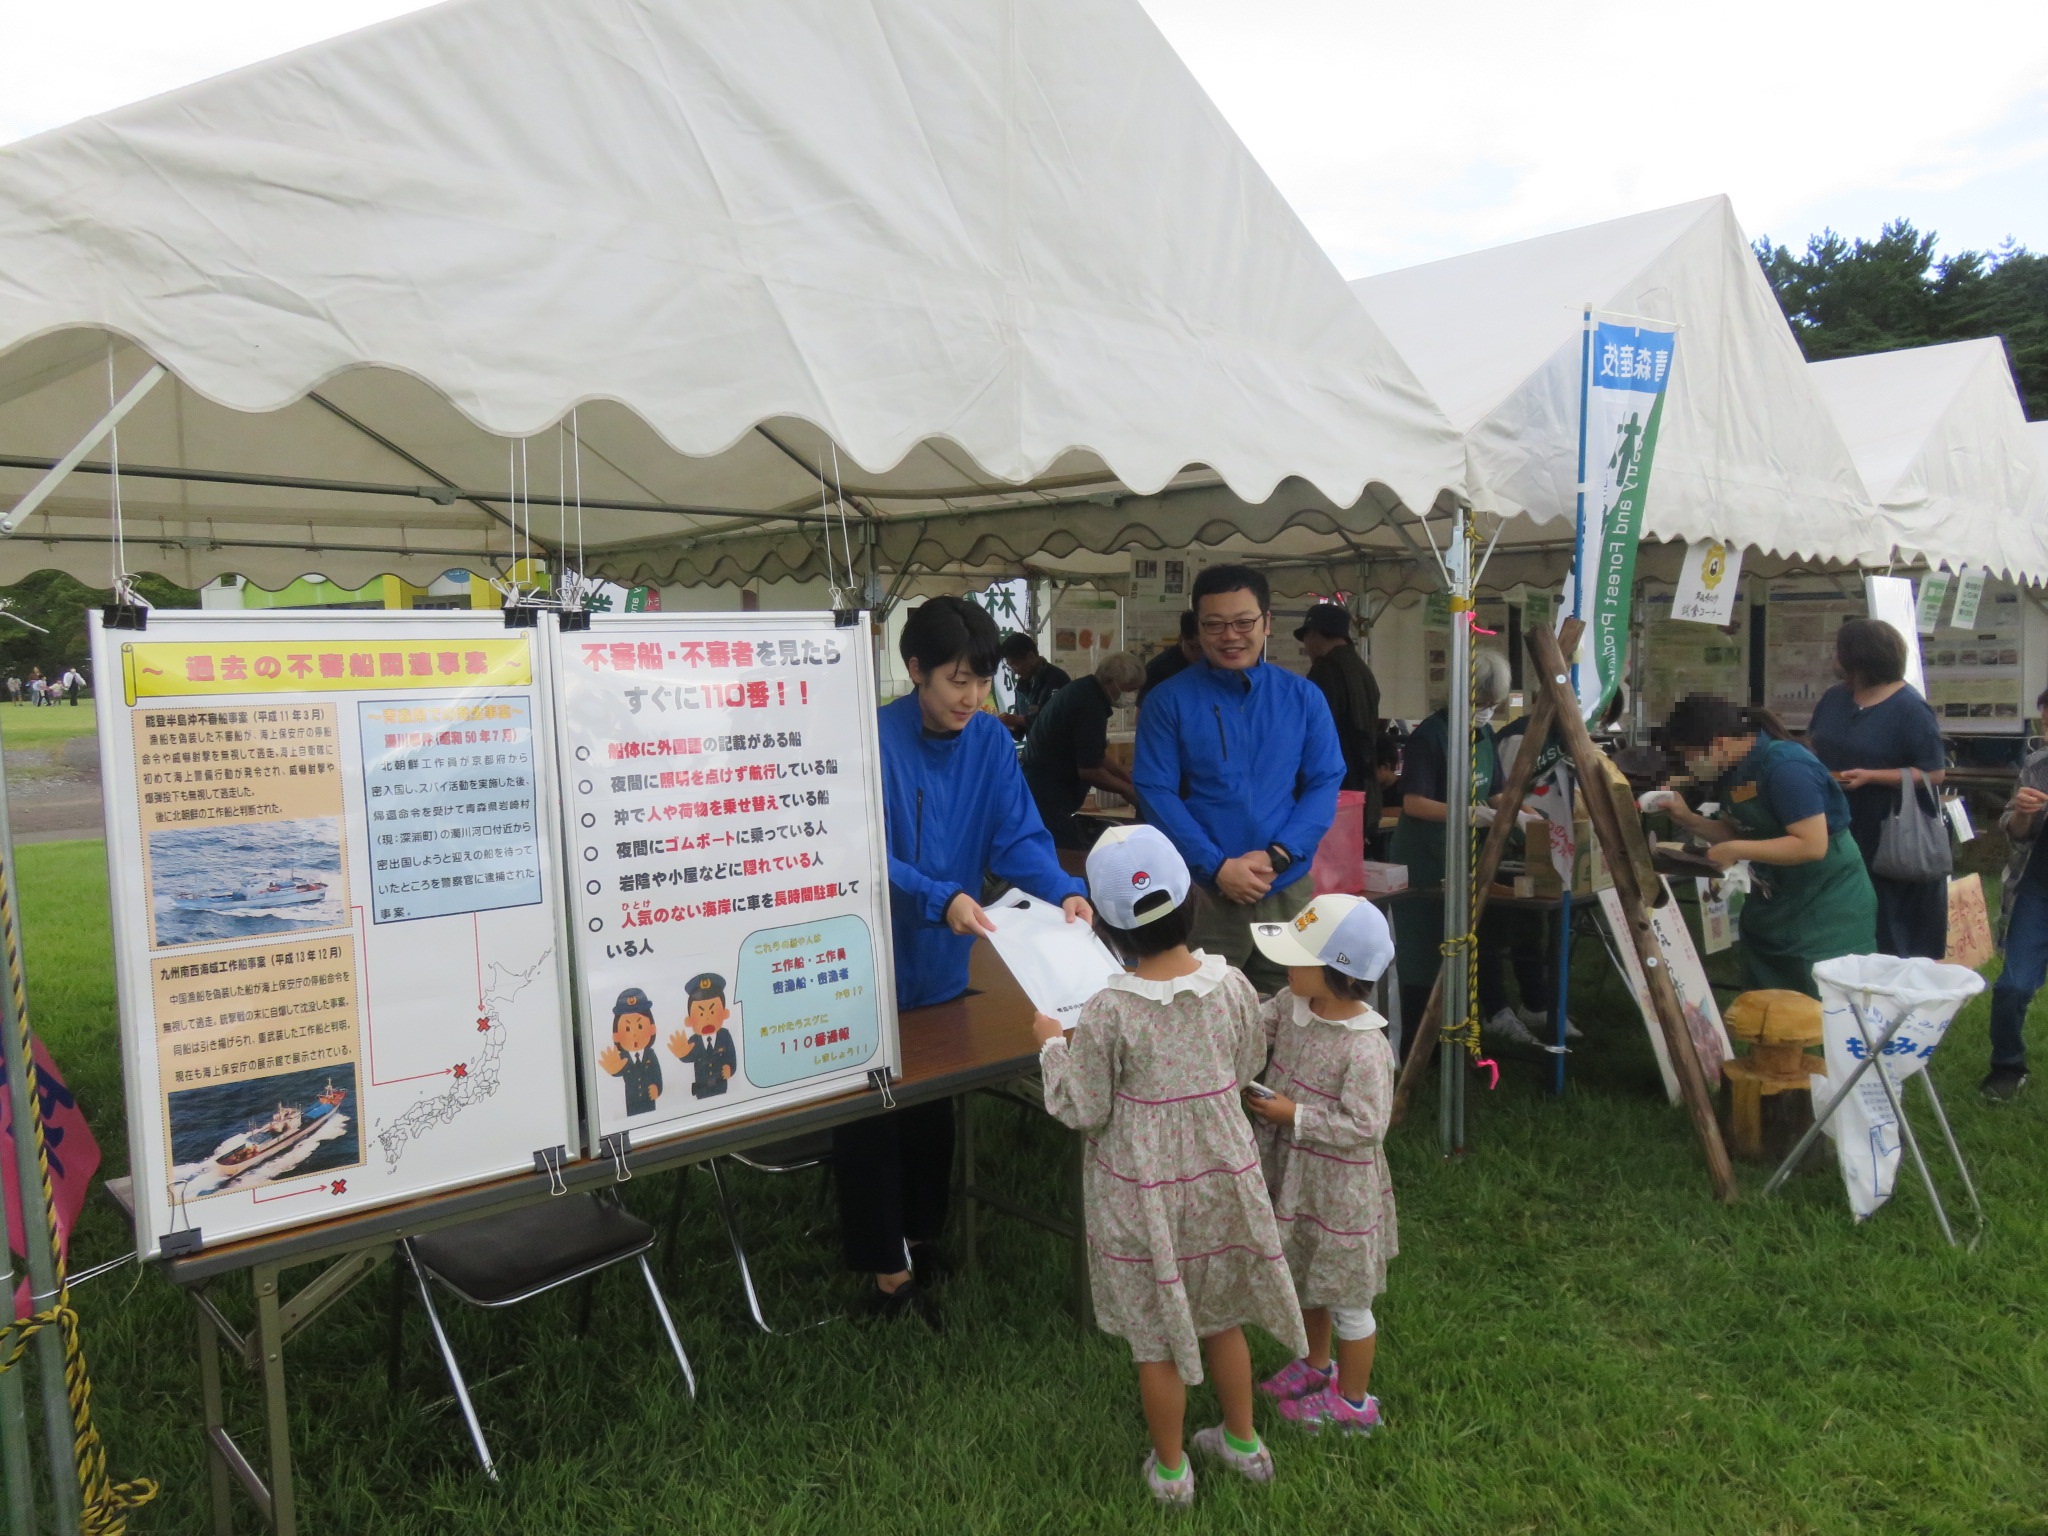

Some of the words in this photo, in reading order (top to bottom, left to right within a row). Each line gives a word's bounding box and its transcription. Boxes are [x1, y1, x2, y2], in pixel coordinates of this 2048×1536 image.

[581, 638, 841, 672] 不審船・不審者を見たら
[381, 752, 528, 772] 北朝鮮工作員が京都府から
[610, 758, 838, 794] 夜間に照明を点けず航行している船
[374, 799, 530, 822] 帰還命令を受けて青森県岩崎村
[614, 790, 830, 826] 沖で人や荷物を乗せ替えている船
[616, 820, 828, 860] 夜間にゴムボートに乗っている人
[376, 846, 532, 871] 密出国しようと迎えの船を待って
[619, 851, 824, 892] 岩陰や小屋などに隠れている人
[378, 868, 535, 894] いたところを警察官に逮捕された
[380, 907, 412, 920] 事案。
[621, 880, 860, 930] 人気のない海岸に車を長時間駐車して
[606, 938, 654, 959] いる人
[772, 948, 846, 974] 工作船・工作員
